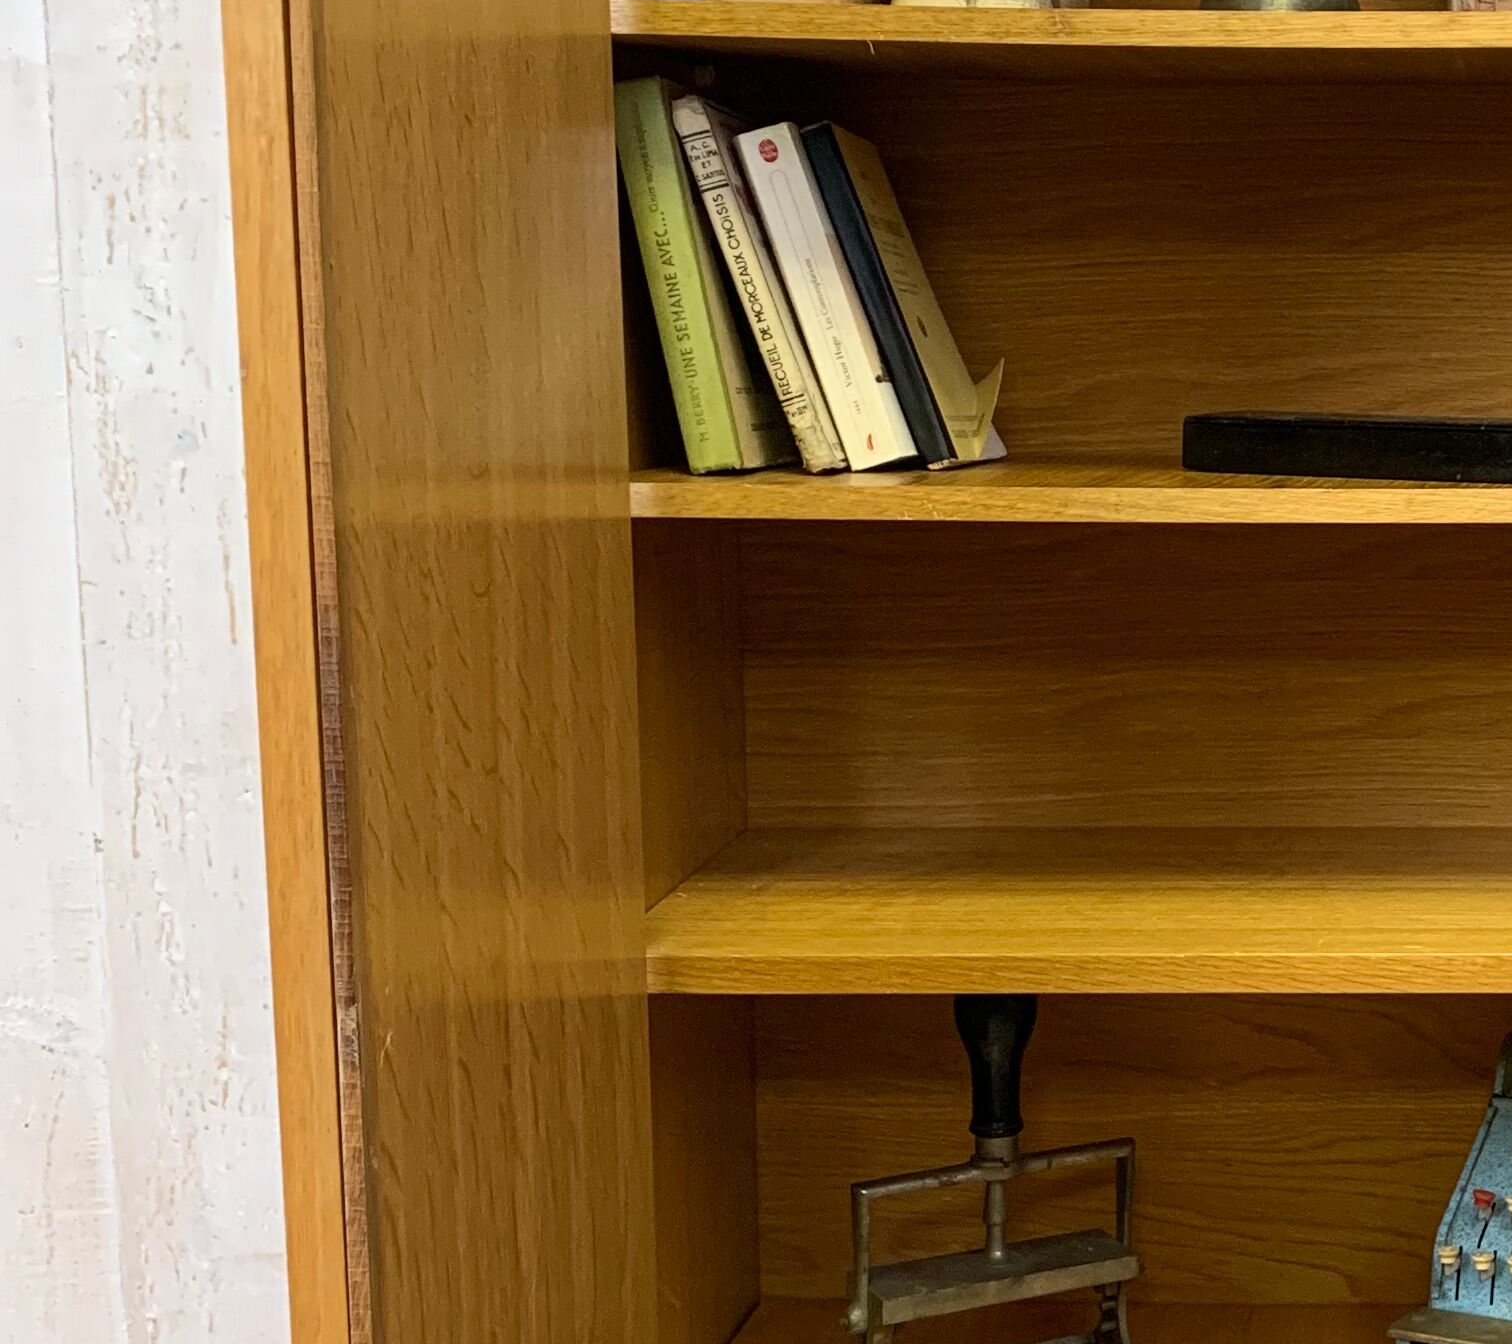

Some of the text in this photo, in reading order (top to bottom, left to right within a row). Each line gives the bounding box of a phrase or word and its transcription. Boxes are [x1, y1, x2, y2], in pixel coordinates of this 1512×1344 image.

[713, 193, 741, 251] CHOISIS
[664, 271, 692, 342] SEMAINE
[732, 252, 767, 324] MORCEAUX
[759, 324, 774, 342] DE
[680, 346, 699, 380] UNE
[766, 343, 793, 397] RECUEIL
[687, 385, 707, 427] BERRY
